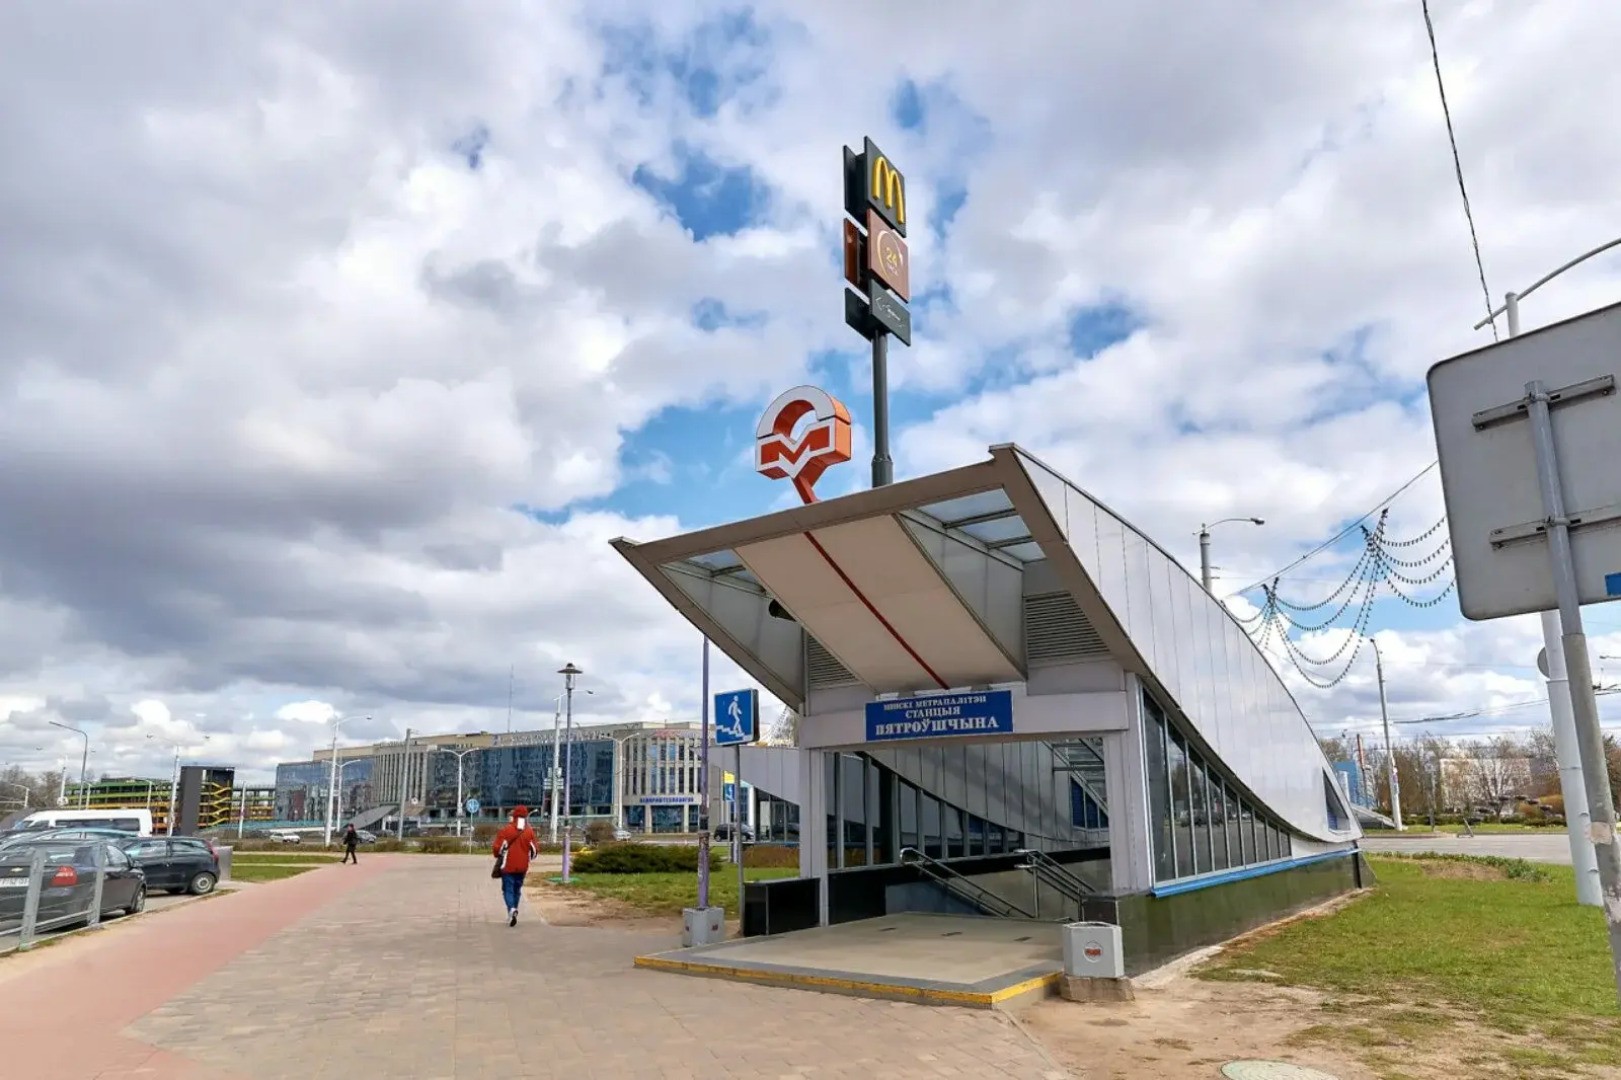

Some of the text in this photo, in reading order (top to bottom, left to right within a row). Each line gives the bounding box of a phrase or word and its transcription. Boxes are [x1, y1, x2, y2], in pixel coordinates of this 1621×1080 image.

[872, 156, 905, 225] M
[915, 695, 987, 708] МЕТРАПАЛІТЭН
[905, 706, 961, 719] СТАНЦЫЯ
[875, 717, 999, 735] ПЯТРОЎШЧЫНА
